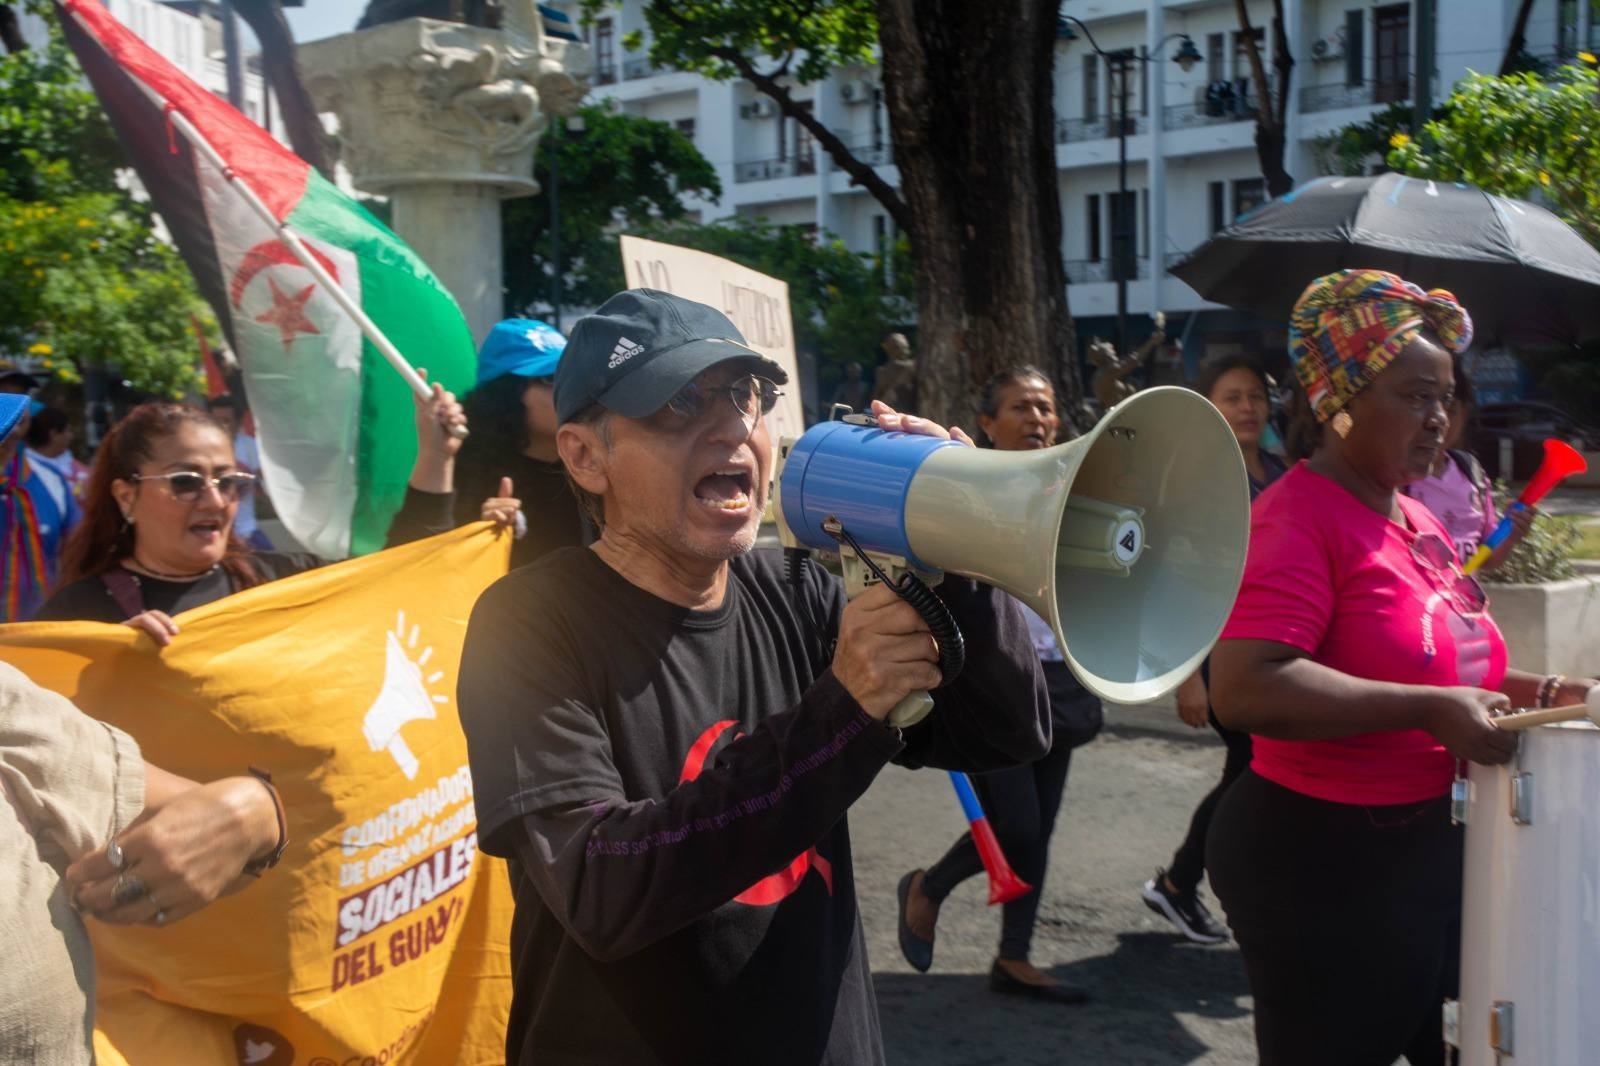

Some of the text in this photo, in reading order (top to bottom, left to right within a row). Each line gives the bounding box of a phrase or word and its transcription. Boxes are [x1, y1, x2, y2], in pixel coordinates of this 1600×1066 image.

[608, 344, 645, 368] adidas
[338, 832, 477, 946] SOCIALES
[331, 940, 384, 992] DEL
